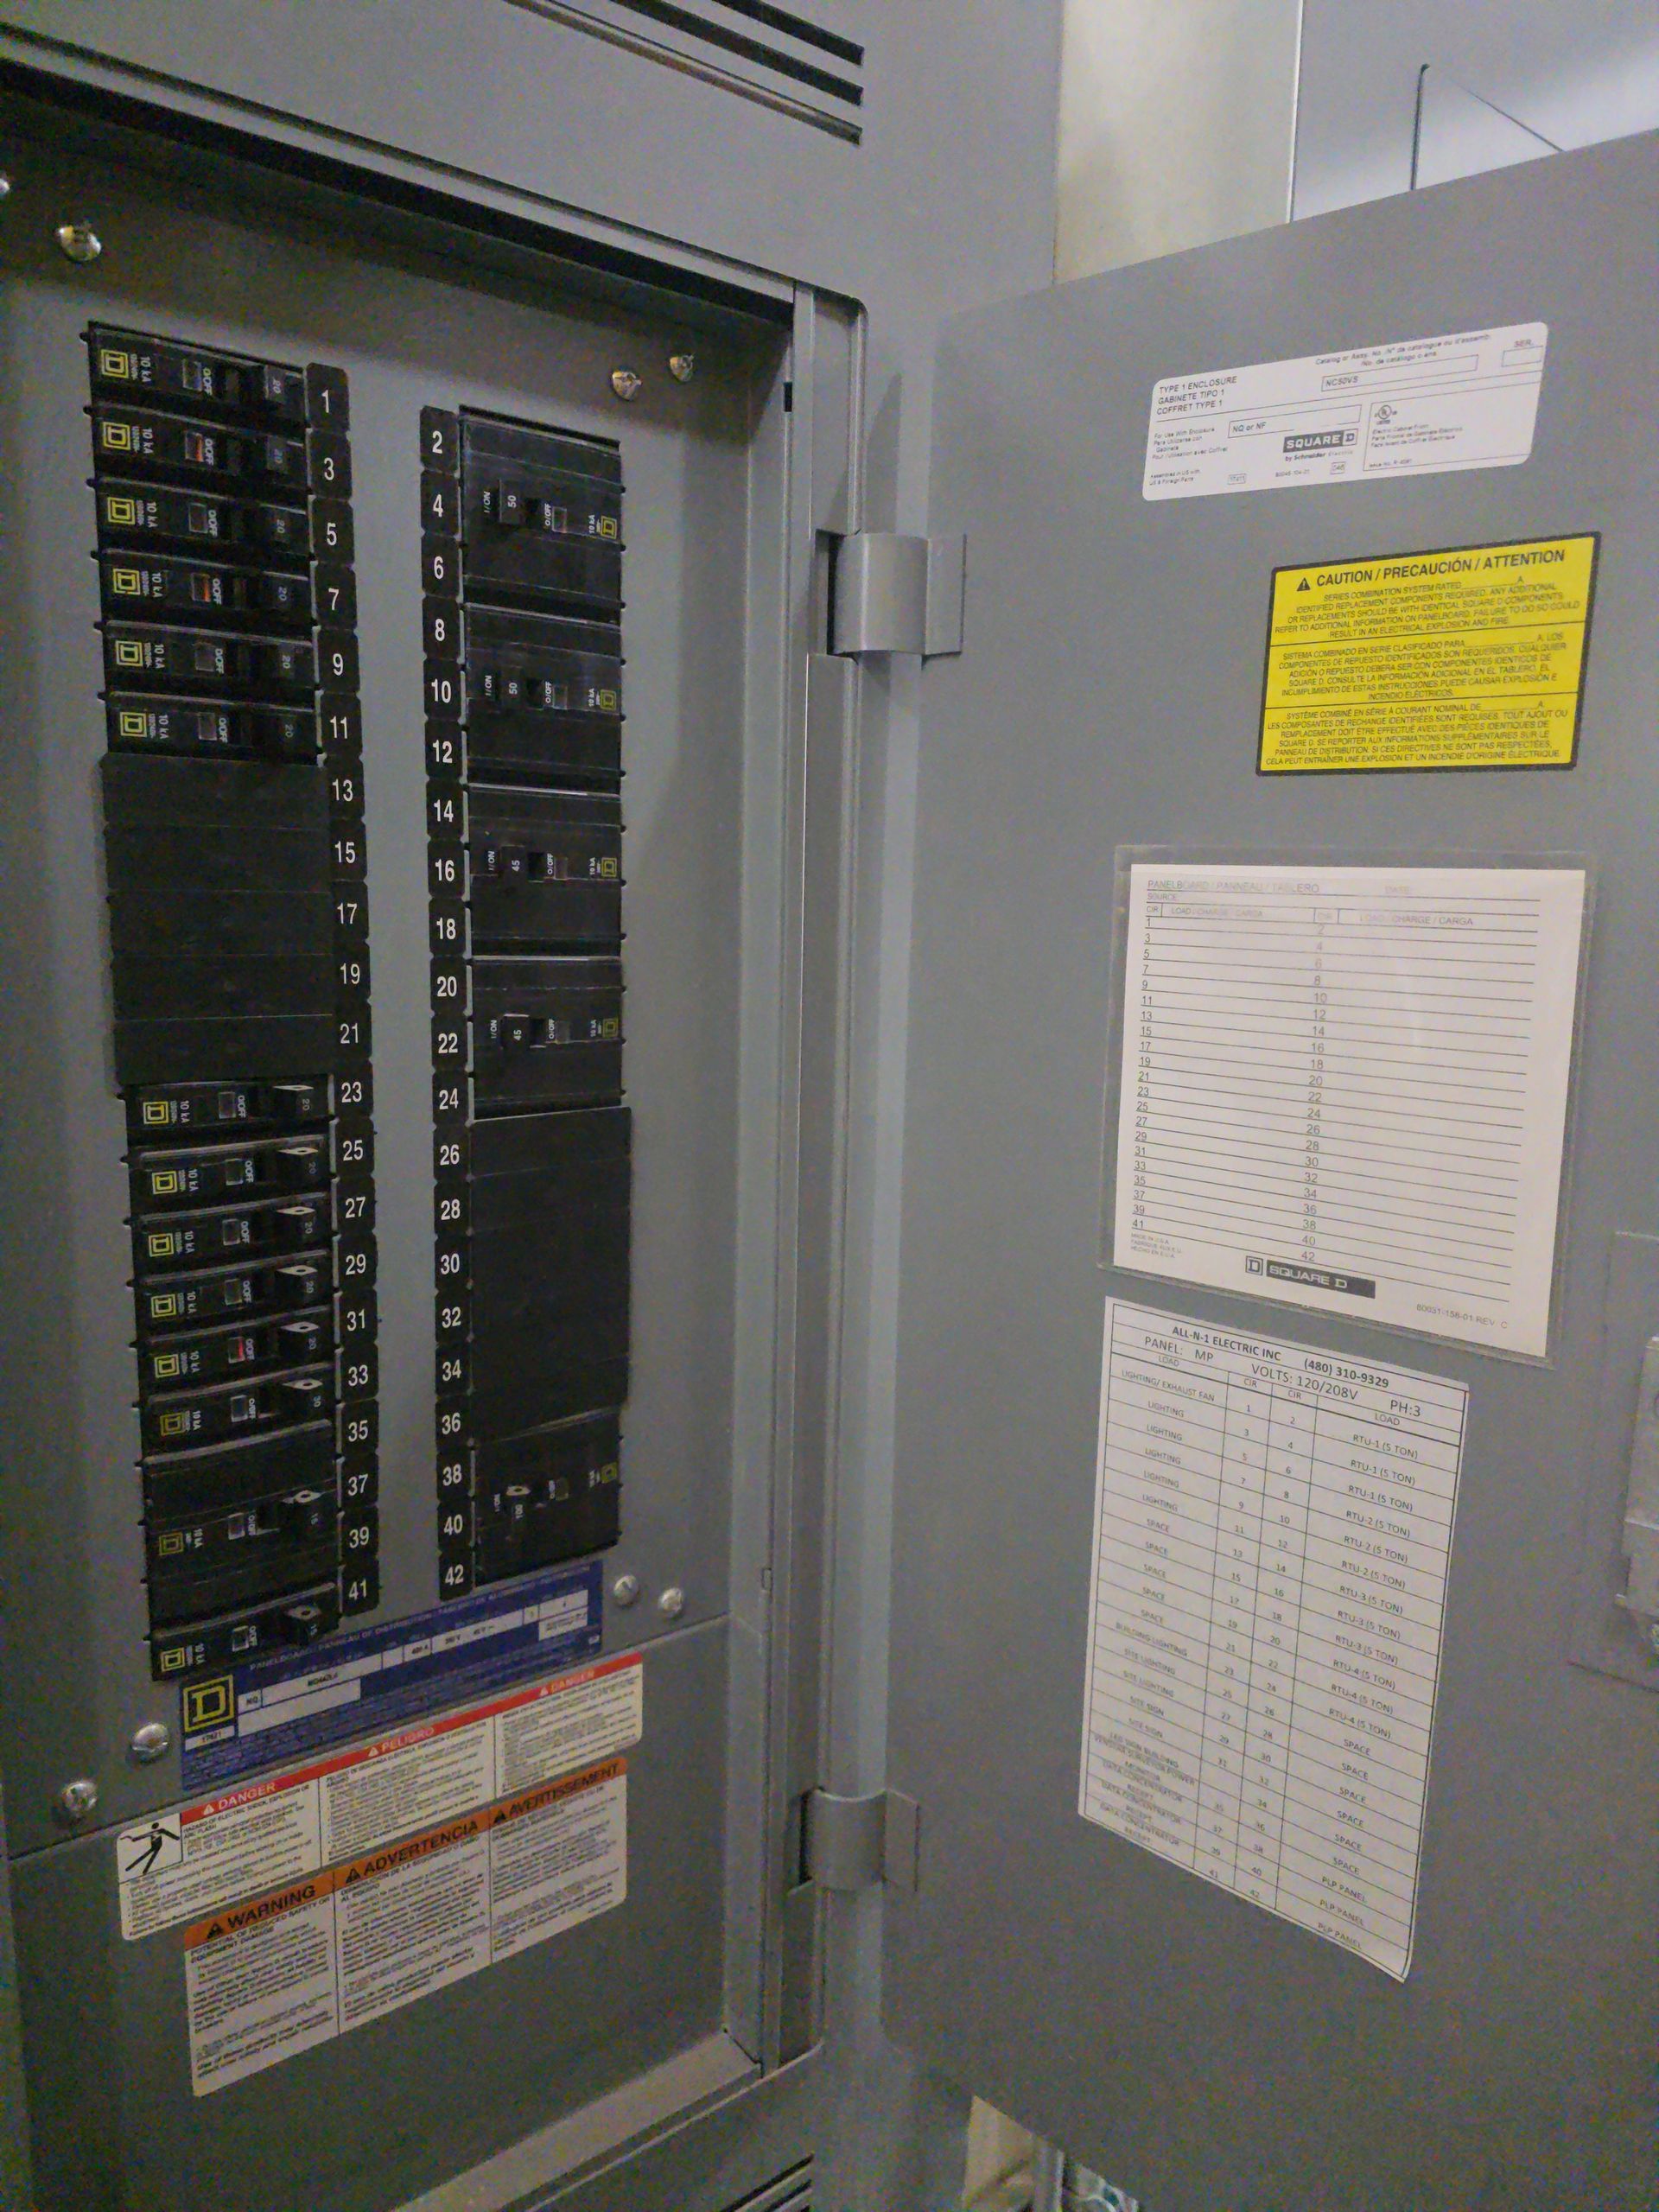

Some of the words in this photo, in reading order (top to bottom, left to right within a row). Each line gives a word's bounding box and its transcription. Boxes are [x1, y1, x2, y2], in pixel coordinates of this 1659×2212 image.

[272, 378, 282, 395] 20
[1159, 384, 1179, 395] TYPE
[1187, 375, 1238, 390] ENCLOSURE
[321, 389, 330, 414] 1
[1156, 404, 1192, 415] COFFRET
[1196, 400, 1215, 409] TYPE
[1158, 393, 1197, 404] GABINETE
[1200, 390, 1218, 398] TIPO
[432, 430, 443, 454] 2
[1286, 435, 1341, 449] SQUARE
[274, 448, 283, 464] 20
[1294, 451, 1325, 461] Schneider
[323, 457, 334, 481] 3
[432, 493, 444, 518] 4
[508, 495, 517, 508] 50
[276, 518, 285, 534] 20
[326, 522, 337, 546] 5
[434, 556, 444, 580] 6
[1317, 569, 1373, 587] CAUTION
[1383, 557, 1471, 580] PRECAUCIÓN
[1483, 550, 1565, 570] ATTENTION
[327, 587, 340, 611] 7
[1324, 591, 1349, 602] SERIES
[1351, 588, 1401, 600] COMBINATION
[1403, 584, 1433, 594] SYSTEM
[435, 618, 445, 642] 8
[332, 652, 344, 677] 9
[1283, 650, 1312, 661] SISTEMA
[1313, 648, 1356, 658] COMBINADO
[430, 678, 452, 703] 10
[509, 683, 518, 696] 50
[329, 715, 348, 740] 11
[432, 739, 453, 764] 12
[1362, 753, 1402, 762] EXPLOSION
[332, 779, 353, 802] 13
[433, 798, 454, 823] 14
[334, 841, 356, 864] 15
[435, 858, 455, 882] 16
[512, 860, 520, 872] 45
[337, 902, 358, 925] 17
[1147, 918, 1151, 927] 1
[1439, 917, 1473, 925] CARGA
[435, 917, 456, 940] 18
[1145, 933, 1151, 943] 3
[340, 963, 360, 985] 19
[1143, 964, 1149, 973] 7
[436, 976, 457, 997] 20
[1314, 975, 1321, 986] 8
[1142, 995, 1153, 1005] 11
[1313, 1008, 1326, 1020] 12
[340, 1022, 359, 1045] 21
[438, 1033, 459, 1054] 22
[514, 1029, 522, 1040] 45
[1141, 1041, 1151, 1051] 17
[1312, 1042, 1325, 1053] 16
[340, 1081, 362, 1103] 23
[439, 1087, 459, 1110] 24
[1137, 1086, 1149, 1096] 23
[1308, 1091, 1322, 1103] 22
[302, 1098, 310, 1111] 20
[1135, 1131, 1147, 1141] 29
[1306, 1140, 1319, 1151] 28
[342, 1139, 364, 1161] 25
[440, 1144, 460, 1166] 26
[1134, 1175, 1146, 1185] 35
[1304, 1187, 1317, 1199] 34
[345, 1196, 366, 1218] 27
[441, 1198, 461, 1221] 28
[1132, 1218, 1144, 1228] 41
[345, 1253, 366, 1275] 29
[440, 1253, 461, 1275] 30
[1301, 1250, 1315, 1262] 42
[1269, 1266, 1330, 1285] SQUARE
[1334, 1278, 1347, 1289] D
[346, 1308, 365, 1332] 31
[442, 1306, 461, 1329] 32
[1476, 1316, 1495, 1326] REV
[1172, 1326, 1209, 1344] ALL-N-1
[1212, 1337, 1259, 1356] ELECTRIC
[1262, 1348, 1281, 1361] INC
[1304, 1357, 1332, 1376] (480)
[1336, 1367, 1389, 1389] 310-9329
[348, 1364, 369, 1387] 33
[442, 1359, 462, 1382] 34
[1145, 1336, 1183, 1355] PANEL:
[1195, 1349, 1213, 1362] MP
[1252, 1363, 1293, 1383] VOLTS:
[1297, 1376, 1358, 1400] 120/208V
[1389, 1400, 1421, 1417] PH:3
[1159, 1356, 1179, 1367] LOAD
[1243, 1378, 1257, 1388] CIR
[1287, 1389, 1301, 1400] CIR
[1375, 1413, 1401, 1426] LOAD
[1162, 1381, 1197, 1396] EXHAUST
[1198, 1390, 1215, 1402] FAN
[1147, 1401, 1185, 1418] LIGHTING
[347, 1419, 369, 1442] 35
[442, 1412, 461, 1435] 36
[1147, 1424, 1183, 1441] LIGHTING
[1352, 1433, 1380, 1448] RTU-1
[1382, 1442, 1392, 1452] (5
[1395, 1446, 1418, 1459] TON)
[347, 1473, 369, 1497] 37
[442, 1464, 462, 1486] 38
[1142, 1494, 1178, 1512] LIGHTING
[443, 1514, 463, 1535] 40
[1147, 1518, 1169, 1533] SPACE
[1280, 1515, 1290, 1524] 10
[1345, 1510, 1373, 1525] RTU-2
[1375, 1518, 1384, 1529] (5
[1387, 1522, 1411, 1538] TON)
[349, 1526, 370, 1548] 39
[444, 1564, 464, 1586] 42
[348, 1579, 367, 1600] 41
[1339, 1586, 1366, 1600] RTU-3
[1380, 1599, 1403, 1614] TON)
[550, 1669, 595, 1693] DANGER
[1333, 1659, 1359, 1675] RTU-4
[1373, 1674, 1395, 1690] TON)
[381, 1727, 435, 1751] PELIGRO
[1343, 1738, 1371, 1756] SPACE
[218, 1783, 276, 1811] DANGER
[508, 1763, 620, 1816] AVERTISSEMENT
[363, 1821, 479, 1876] ADVERTENCIA
[1321, 1876, 1337, 1887] PLP
[227, 1885, 316, 1929] WARNING
